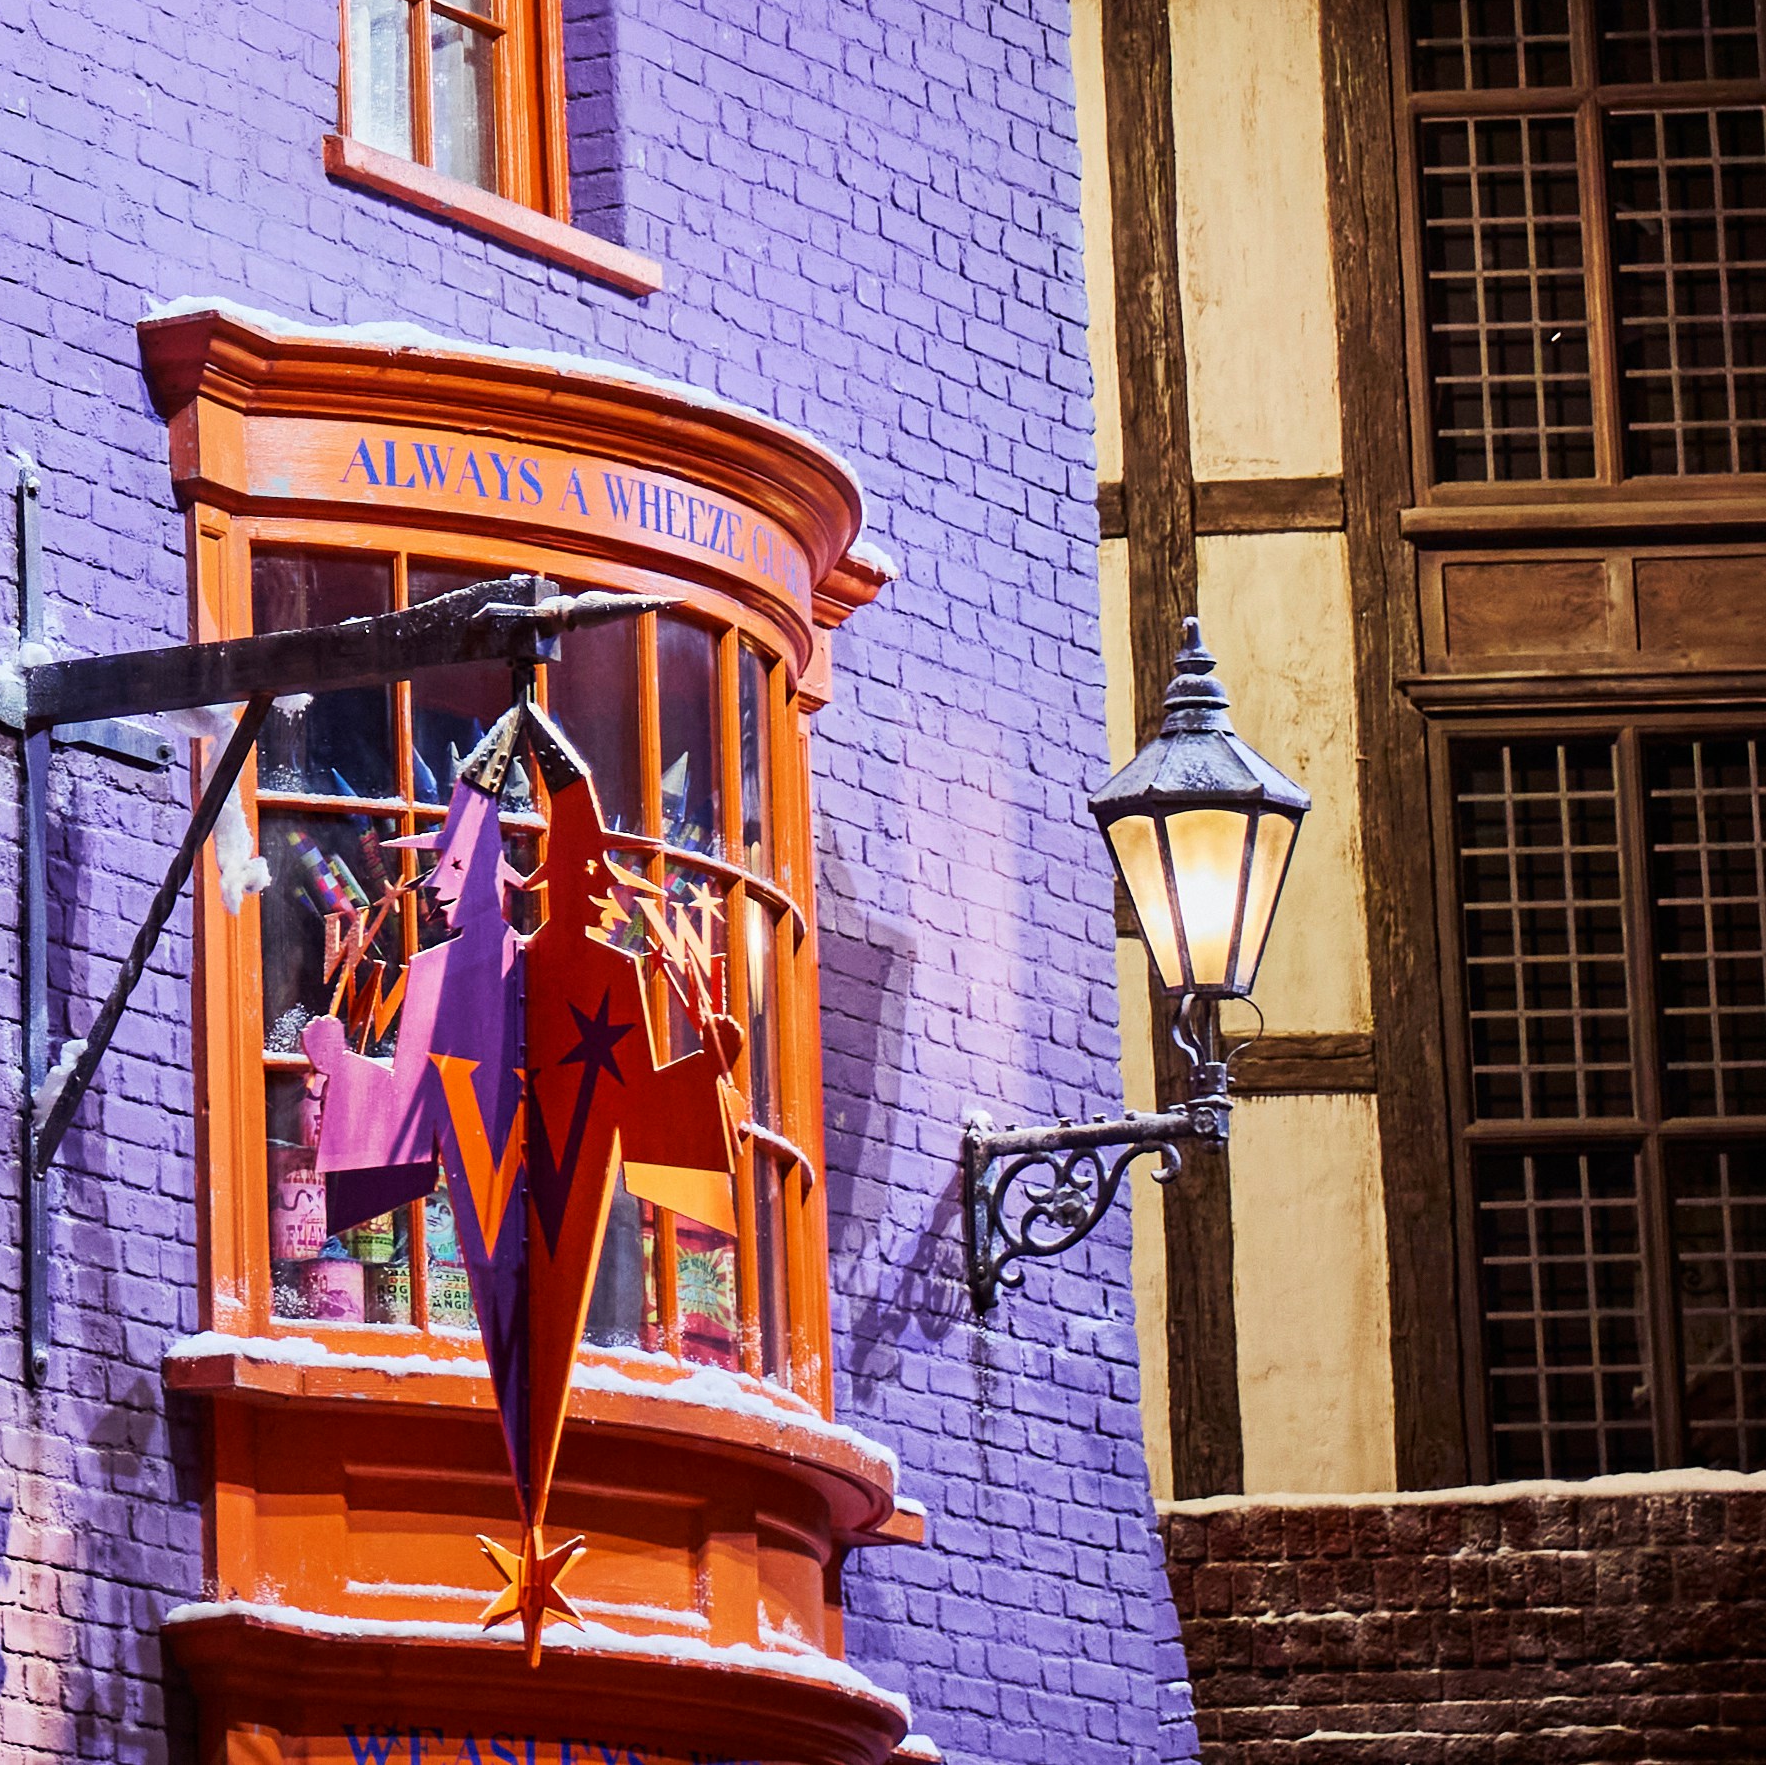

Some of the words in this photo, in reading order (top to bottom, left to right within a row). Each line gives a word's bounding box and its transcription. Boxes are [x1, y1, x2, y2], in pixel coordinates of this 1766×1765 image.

[338, 437, 543, 506] ALWAYS
[559, 467, 590, 516] A
[600, 471, 745, 563] WHEEZE
